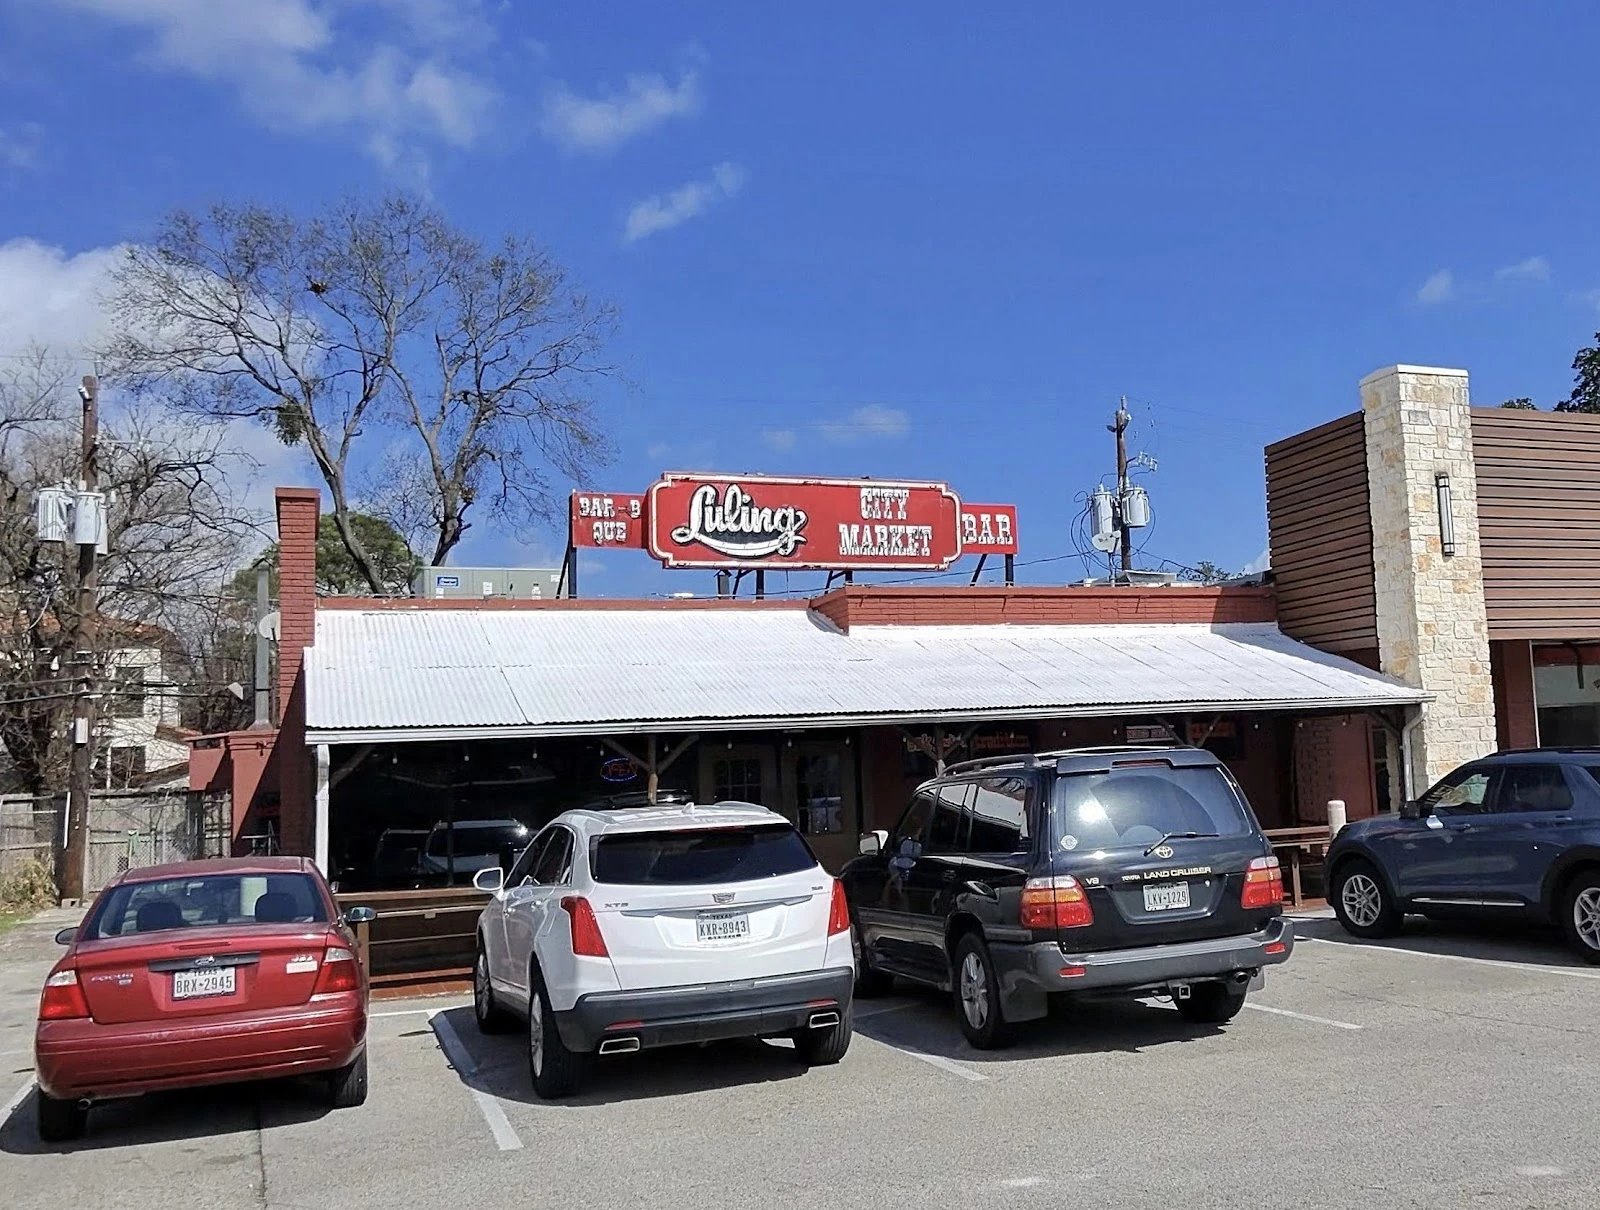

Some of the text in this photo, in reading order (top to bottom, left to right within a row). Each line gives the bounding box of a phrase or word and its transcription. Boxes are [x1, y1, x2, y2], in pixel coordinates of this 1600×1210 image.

[671, 483, 808, 556] Luling
[860, 487, 910, 520] CITY
[593, 521, 627, 545] QUE
[838, 523, 933, 557] MARKET
[961, 513, 1013, 545] BAR
[1085, 877, 1100, 885] V8
[1143, 870, 1170, 880] LAND
[1170, 866, 1212, 877] CRUISER
